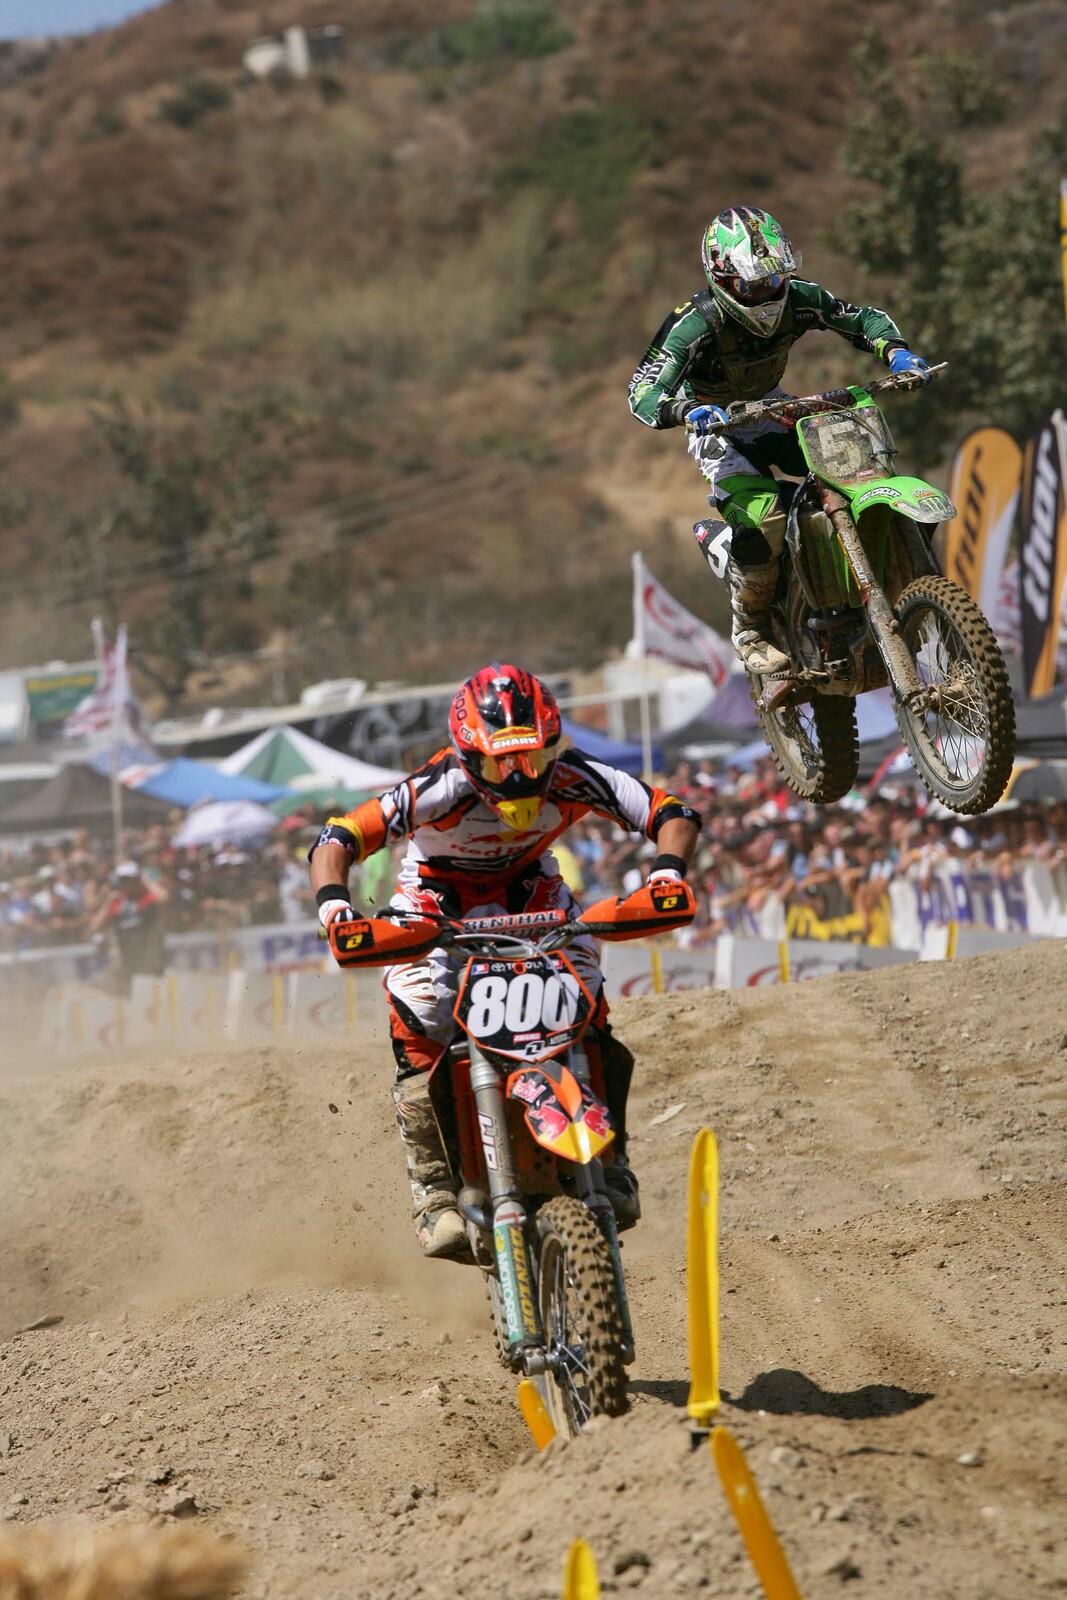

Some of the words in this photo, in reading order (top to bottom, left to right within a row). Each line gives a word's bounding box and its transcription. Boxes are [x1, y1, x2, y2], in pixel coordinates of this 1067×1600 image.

[492, 736, 538, 750] SHARK
[463, 912, 560, 931] RENTHAL
[467, 973, 580, 1037] 800
[498, 1252, 519, 1337] MOTOREX
[510, 1227, 537, 1335] DUNLOP
